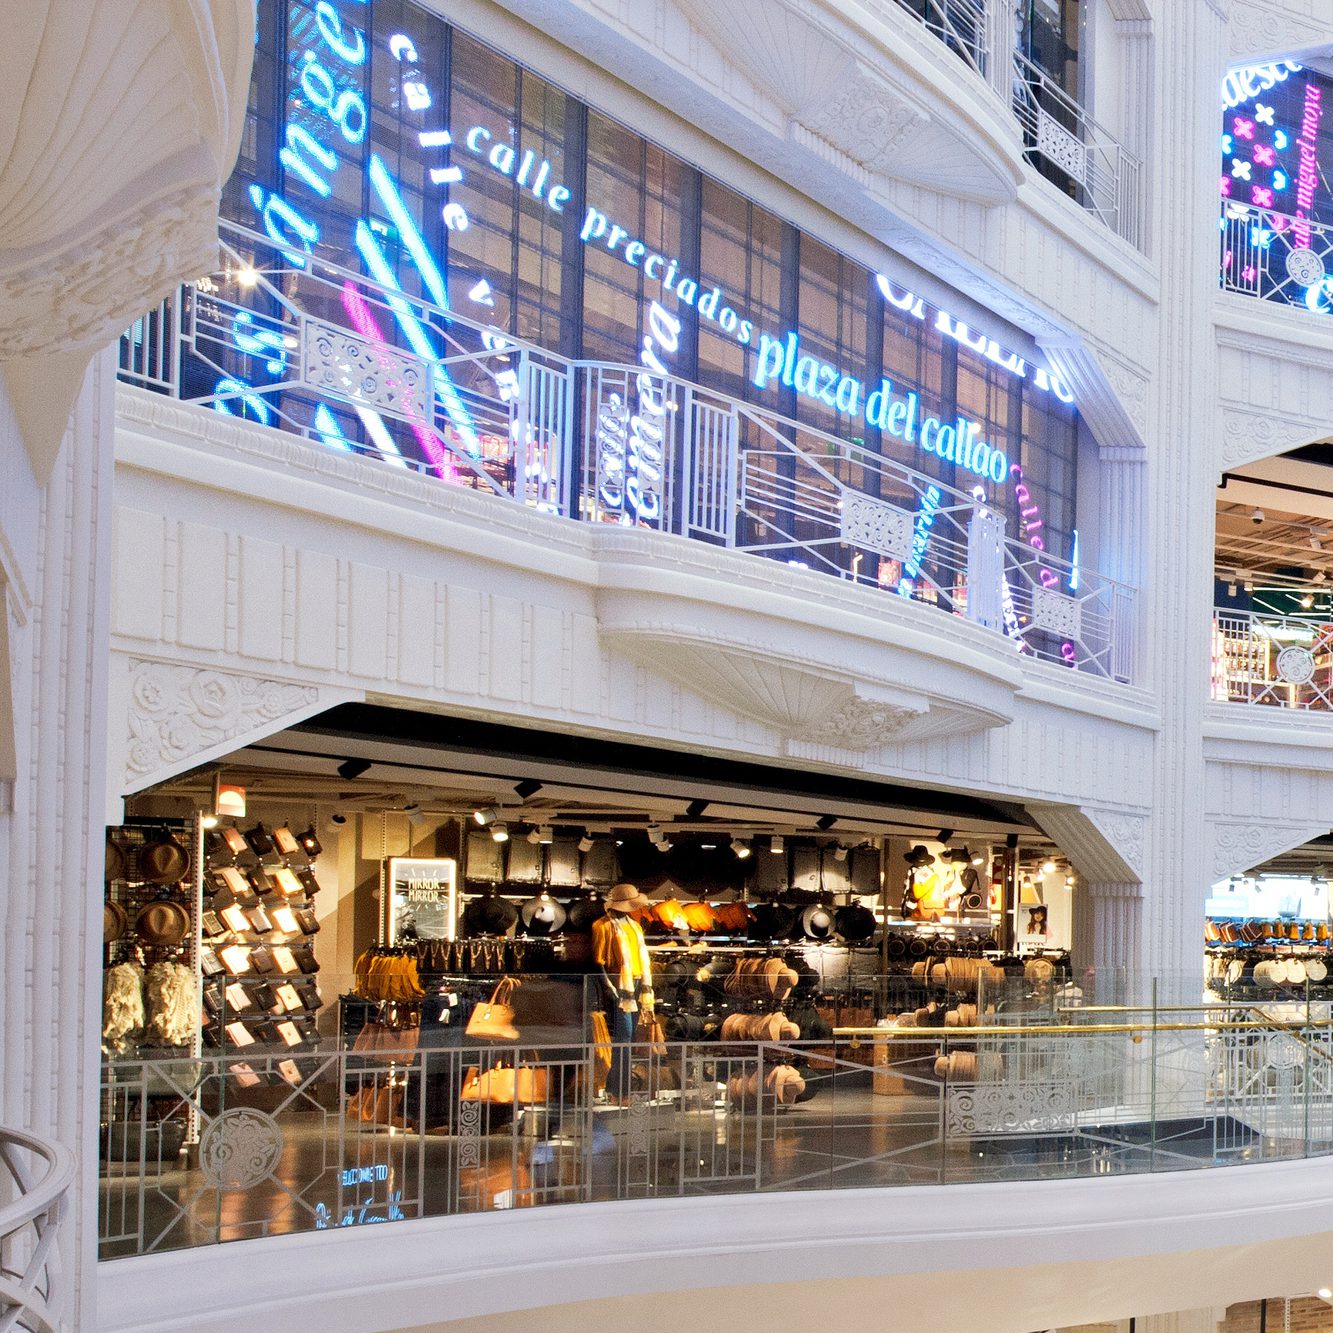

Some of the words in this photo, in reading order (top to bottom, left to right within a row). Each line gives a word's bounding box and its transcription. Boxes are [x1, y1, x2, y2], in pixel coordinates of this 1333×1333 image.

[466, 124, 571, 212] calle
[580, 205, 754, 344] preciados
[753, 332, 861, 417] plaza
[865, 378, 917, 443] del
[921, 416, 1009, 484] callao
[408, 878, 440, 890] MIRROR
[408, 890, 439, 903] MIRROR
